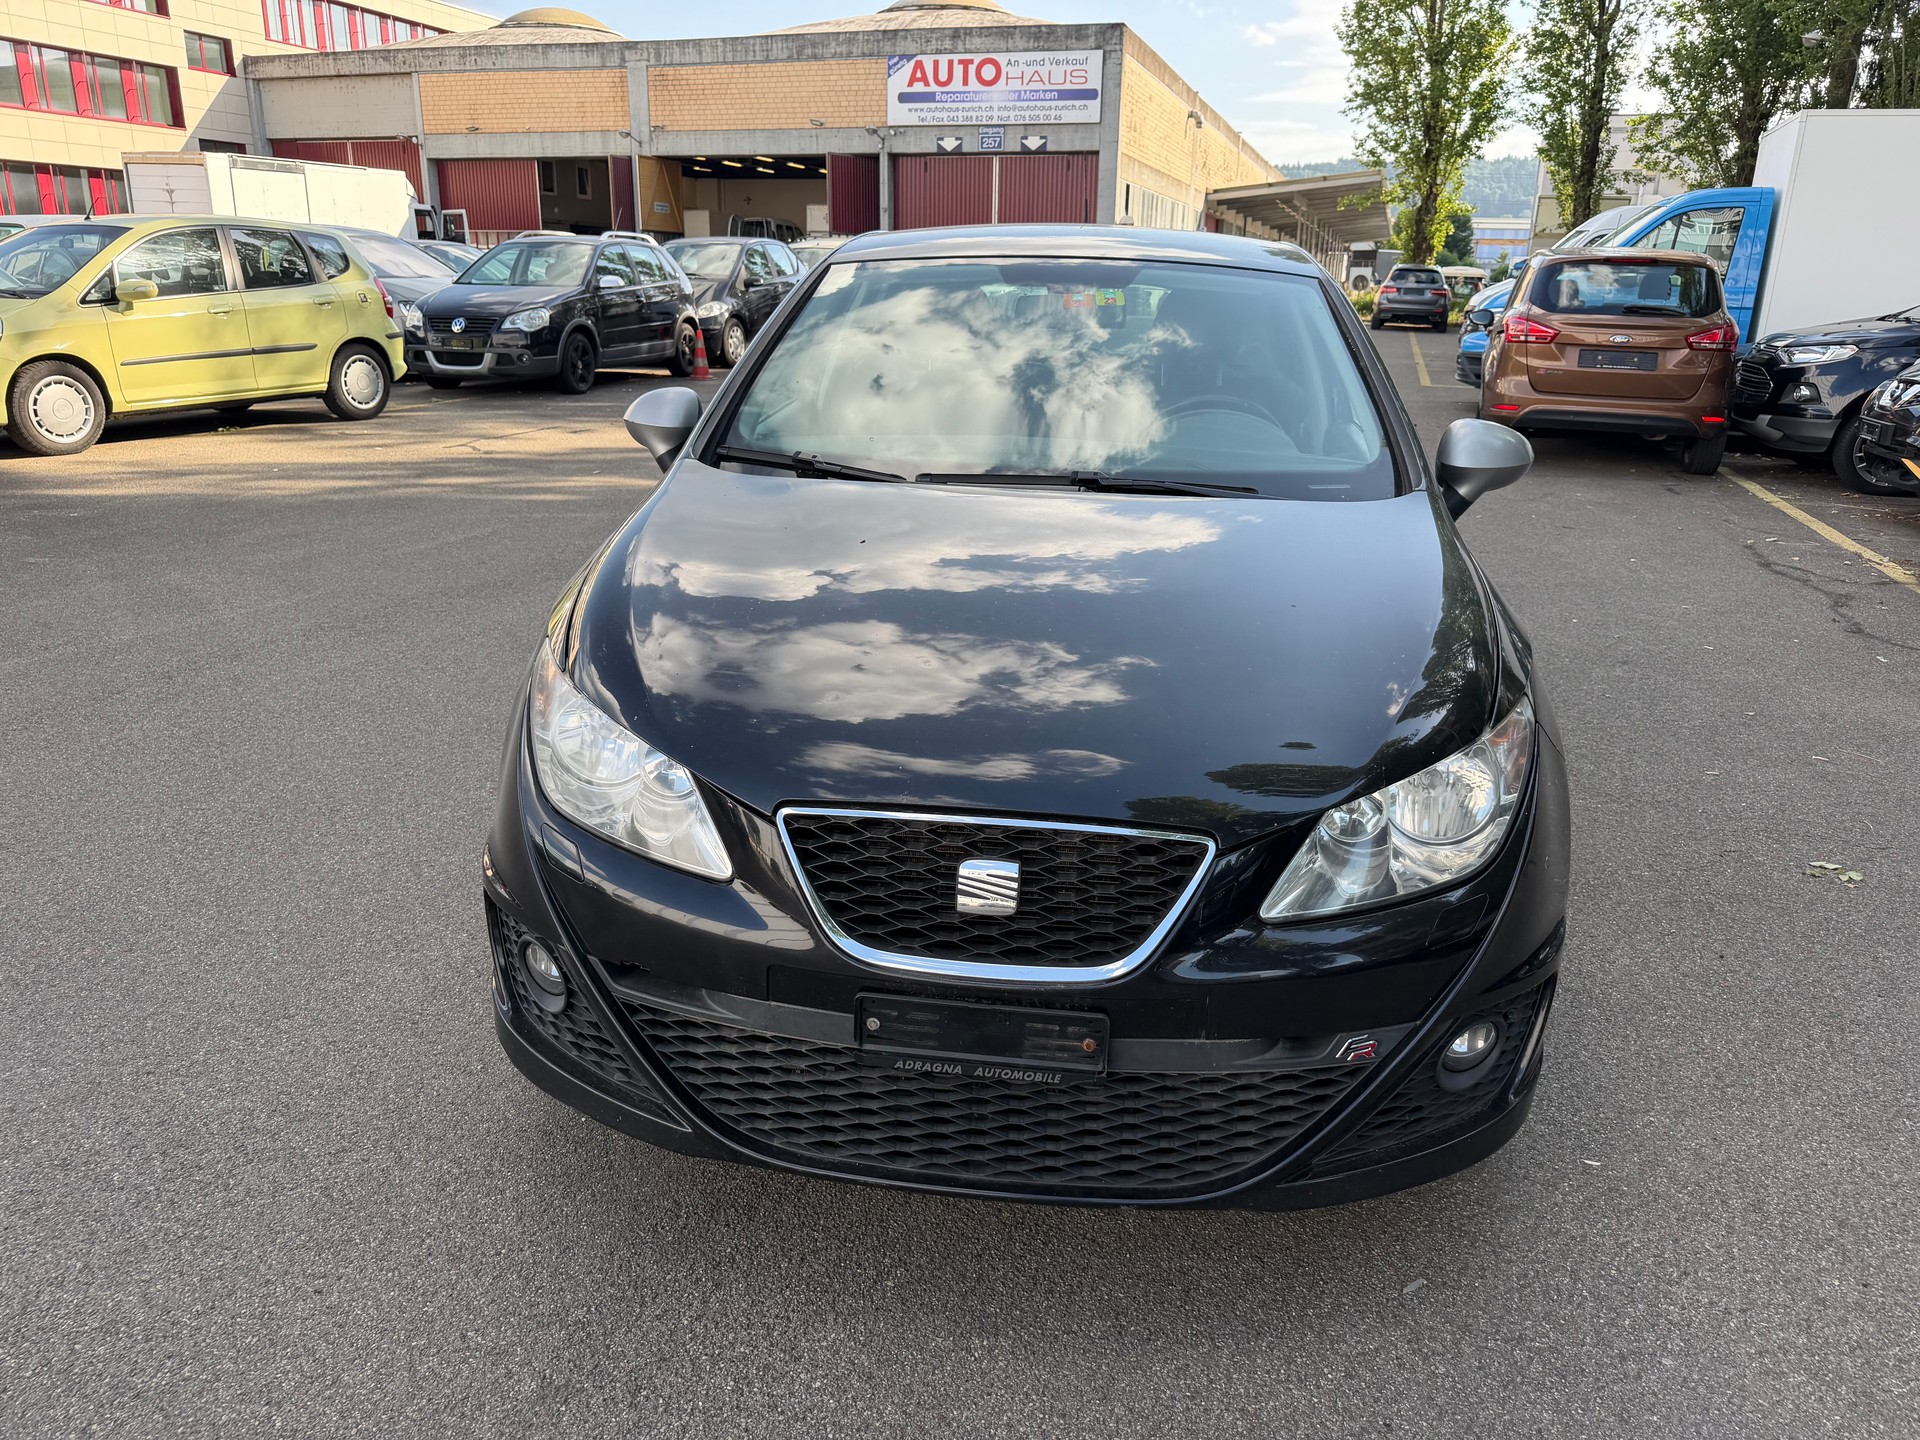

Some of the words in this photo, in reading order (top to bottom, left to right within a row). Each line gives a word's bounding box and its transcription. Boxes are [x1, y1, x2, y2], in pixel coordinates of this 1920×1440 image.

[1006, 58, 1019, 67] An
[1048, 56, 1088, 66] Verkauf
[907, 57, 1002, 87] AUTO
[1005, 69, 1088, 86] HAUS
[1021, 90, 1058, 100] Marken
[946, 115, 959, 123] 043
[979, 127, 1004, 135] Eingang
[982, 137, 1000, 148] 257
[1336, 1034, 1377, 1060] FR
[894, 1058, 963, 1075] ADRAGNA
[974, 1067, 1062, 1084] AUTOMOBILE
